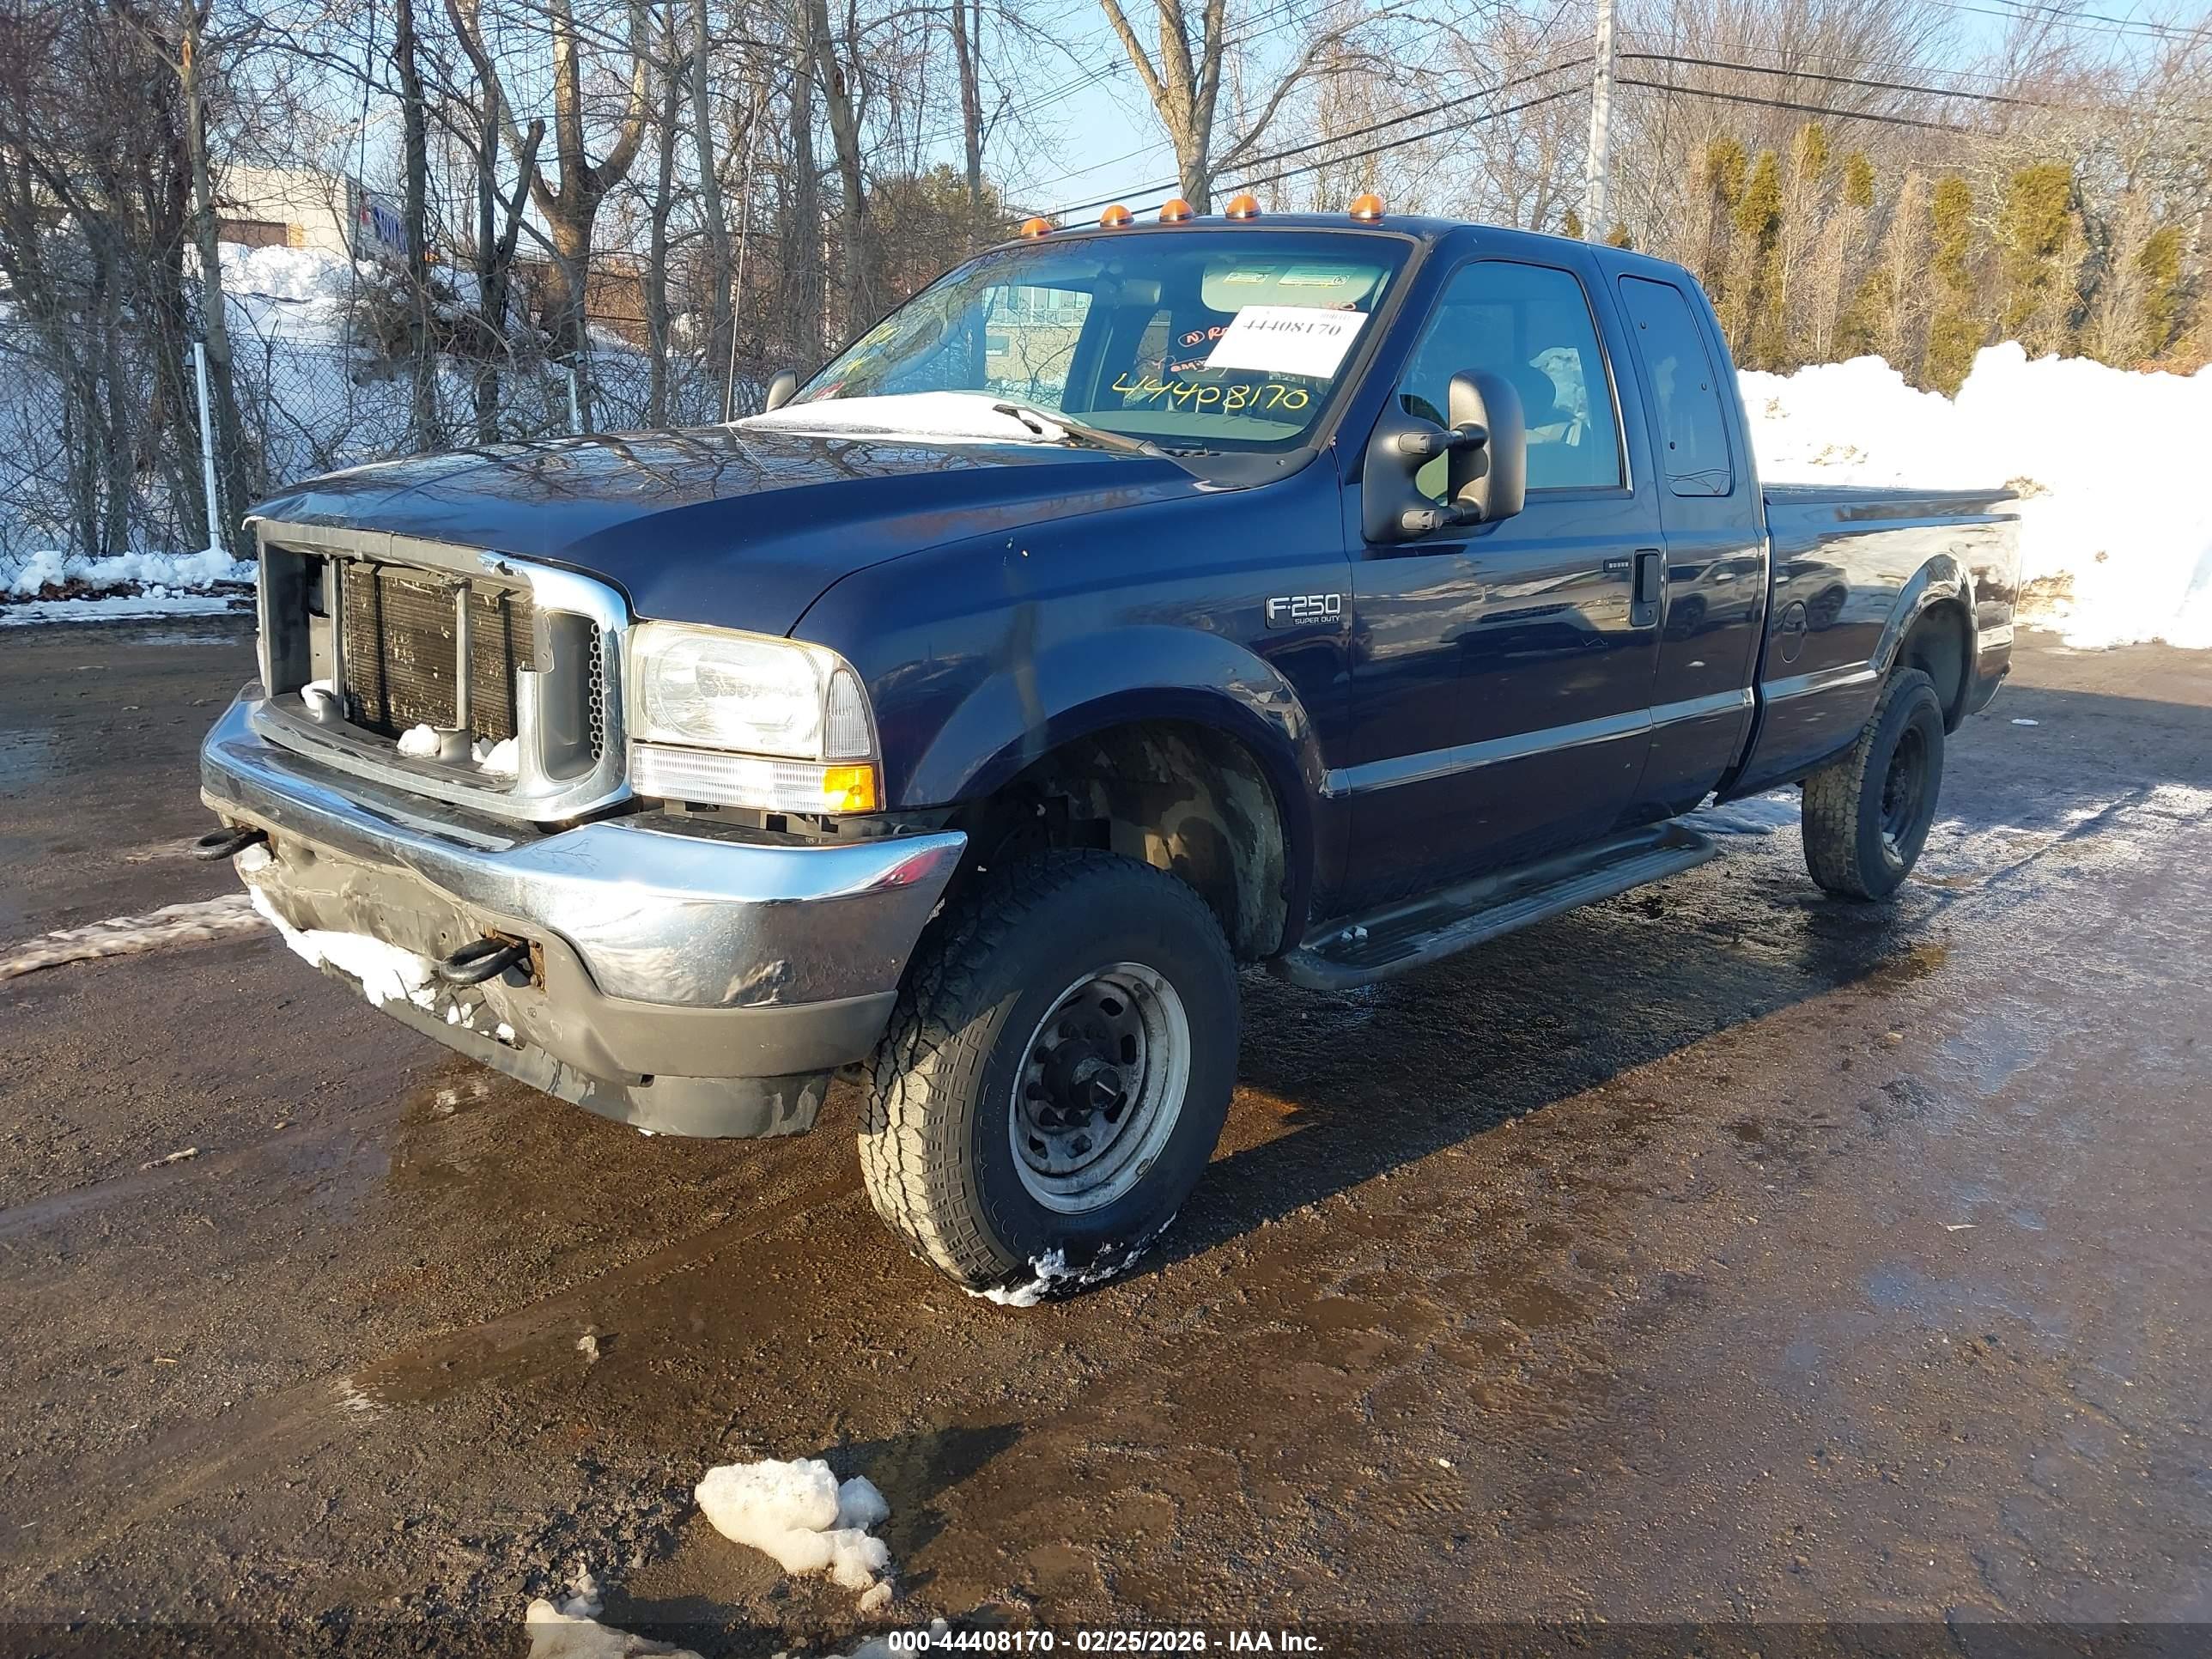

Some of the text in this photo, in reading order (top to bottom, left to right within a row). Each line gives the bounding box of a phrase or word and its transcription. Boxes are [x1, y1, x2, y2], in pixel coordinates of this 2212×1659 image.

[1243, 319, 1341, 336] 44408170
[1112, 373, 1310, 410] 44408170
[1294, 615, 1340, 625] SUPER DUTY
